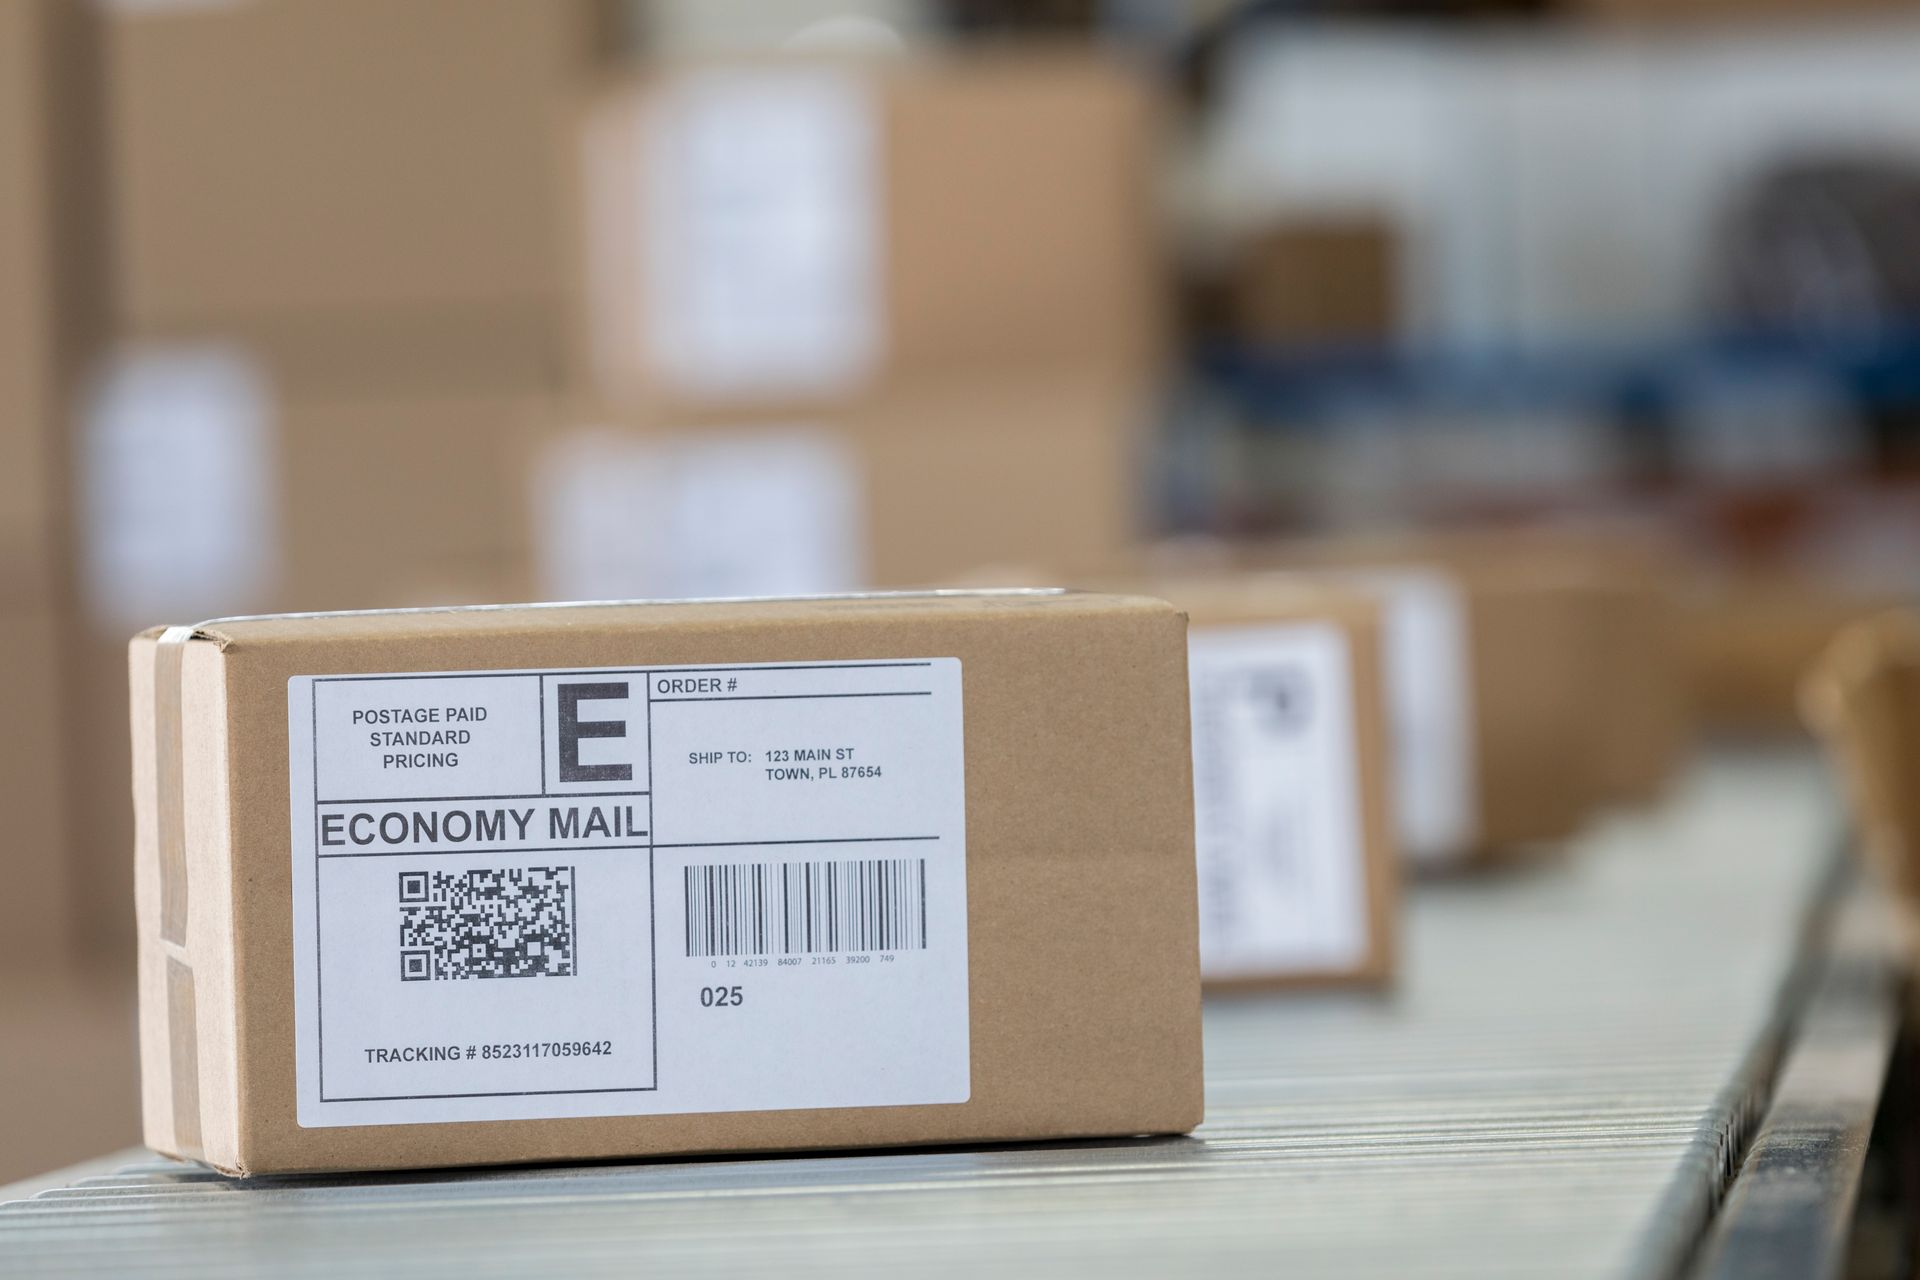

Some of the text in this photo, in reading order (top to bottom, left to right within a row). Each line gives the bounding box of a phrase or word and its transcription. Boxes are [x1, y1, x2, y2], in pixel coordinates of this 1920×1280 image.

[657, 677, 738, 694] ORDER #
[352, 706, 488, 725] POSTAGE PAID
[369, 729, 471, 747] STANDARD
[558, 682, 632, 782] E
[383, 752, 459, 769] PRICING
[688, 750, 752, 765] SHIP TO:
[765, 747, 855, 763] 123 MAIN ST
[765, 765, 882, 782] TOWN, PL 87654
[321, 806, 648, 846] ECONOMY MAIL
[726, 960, 736, 968] 12
[743, 958, 769, 967] 42139
[777, 957, 802, 966] 84007
[811, 956, 836, 965] 21165
[880, 954, 895, 963] 749
[701, 986, 743, 1007] 025
[364, 1040, 612, 1064] TRACKING # 8523117059642
